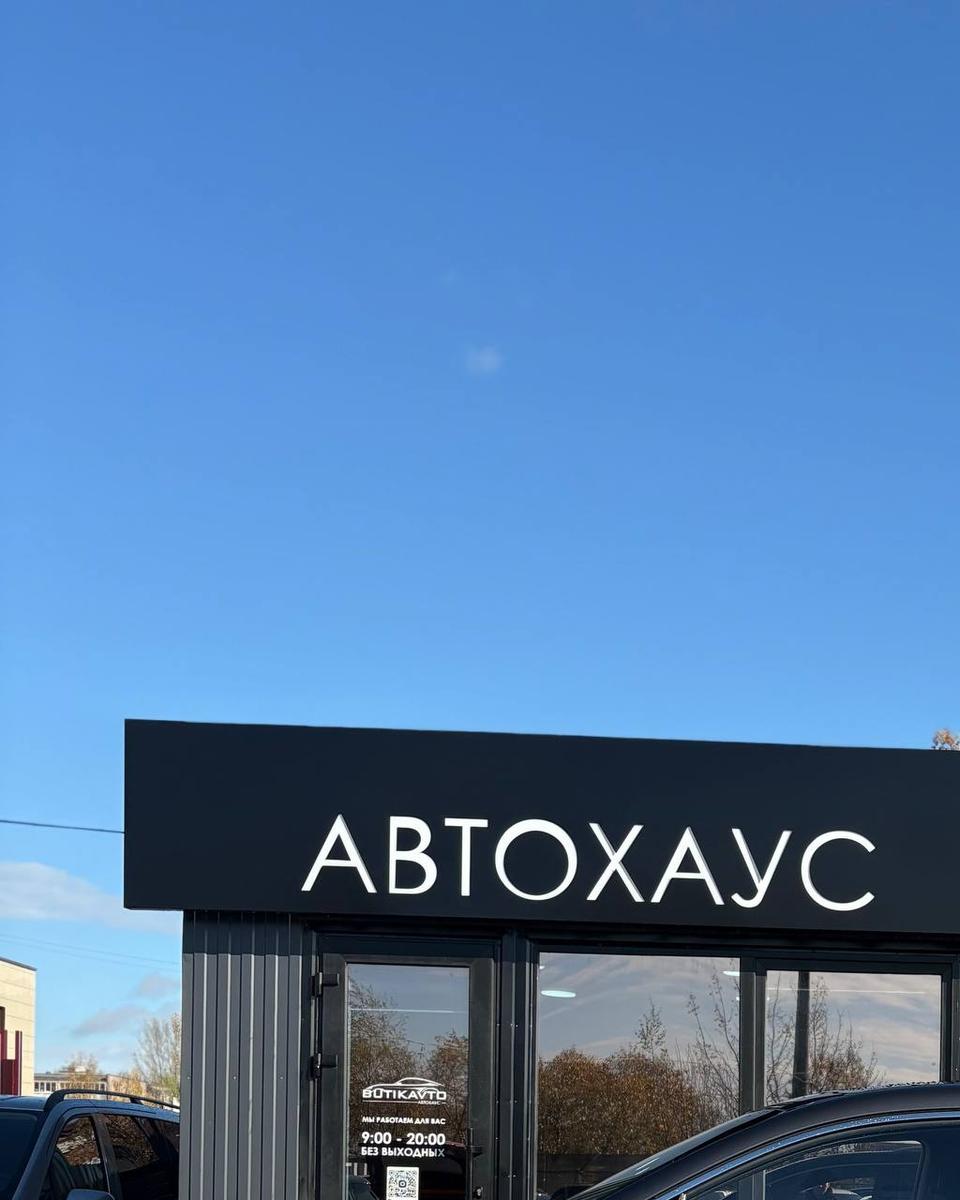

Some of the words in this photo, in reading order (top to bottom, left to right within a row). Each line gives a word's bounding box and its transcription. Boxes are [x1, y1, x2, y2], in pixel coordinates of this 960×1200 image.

[301, 814, 877, 912] АВТОХАУС
[362, 1089, 447, 1100] BUTIKAVTO
[361, 1131, 392, 1144] 9:00
[406, 1132, 446, 1146] 20:00
[361, 1146, 379, 1156] БЕЗ
[381, 1147, 445, 1158] ВЫХОДНЫХ
